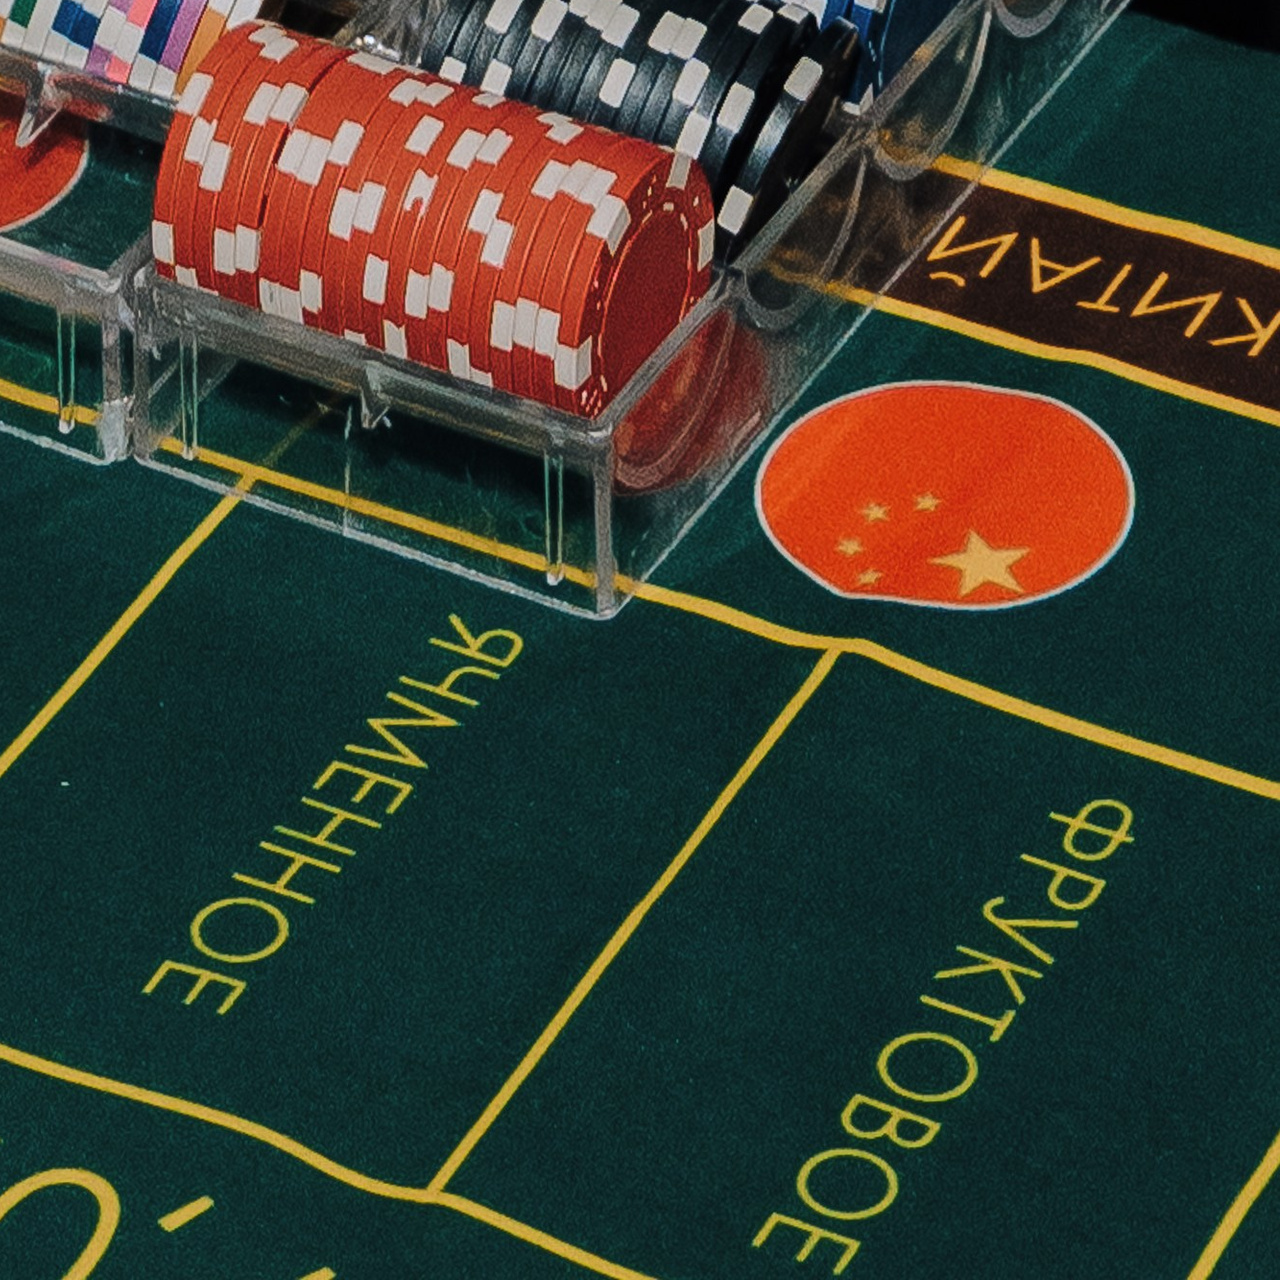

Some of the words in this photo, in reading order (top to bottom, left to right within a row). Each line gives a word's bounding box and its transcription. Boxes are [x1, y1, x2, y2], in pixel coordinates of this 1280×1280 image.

[926, 215, 1280, 358] КИТАЙ
[142, 613, 524, 1016] ЯЧМЕННОЕ
[751, 798, 1135, 1276] ФРУКТОВОЕ
